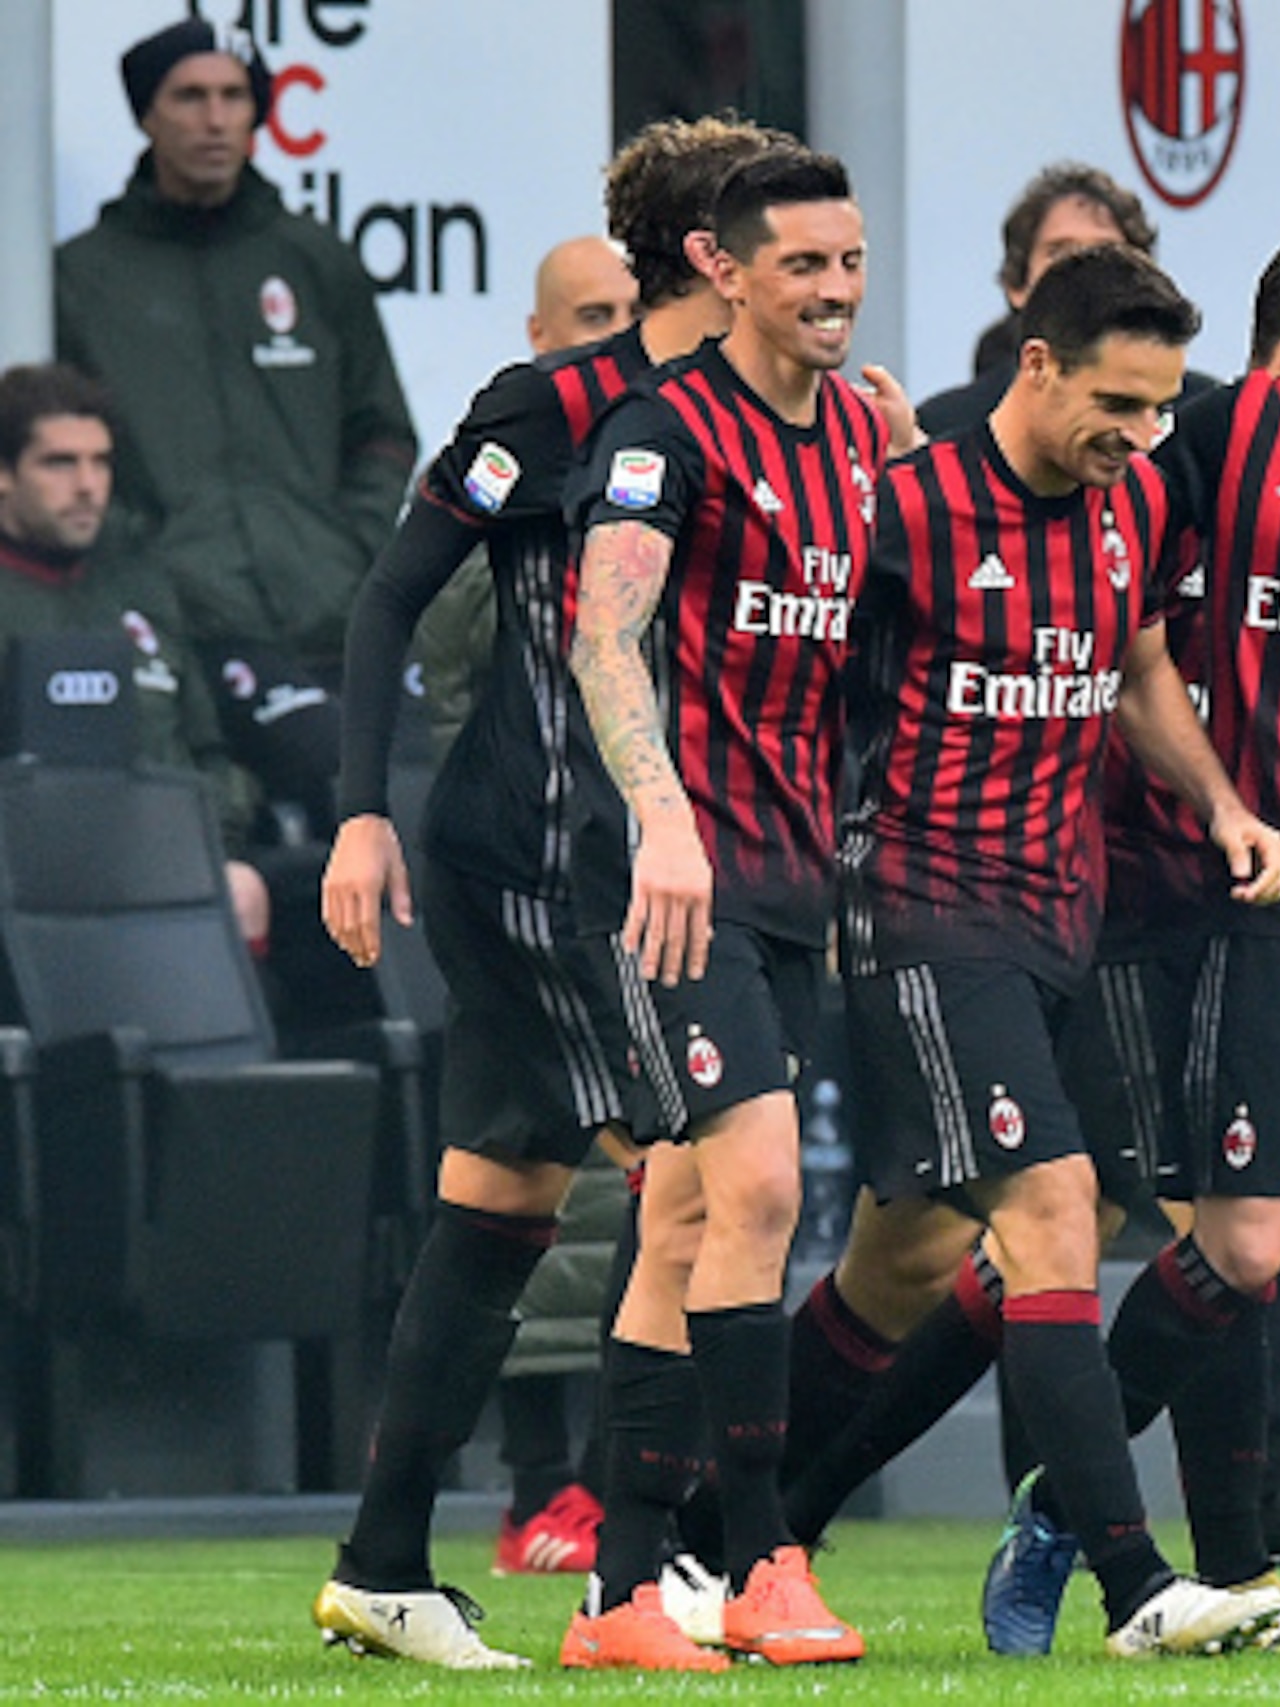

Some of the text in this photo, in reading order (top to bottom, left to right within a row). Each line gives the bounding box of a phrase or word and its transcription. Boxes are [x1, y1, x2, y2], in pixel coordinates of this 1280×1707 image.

[803, 545, 852, 592] Fly
[1034, 627, 1093, 670] Fly
[946, 661, 1122, 718] Emirate
